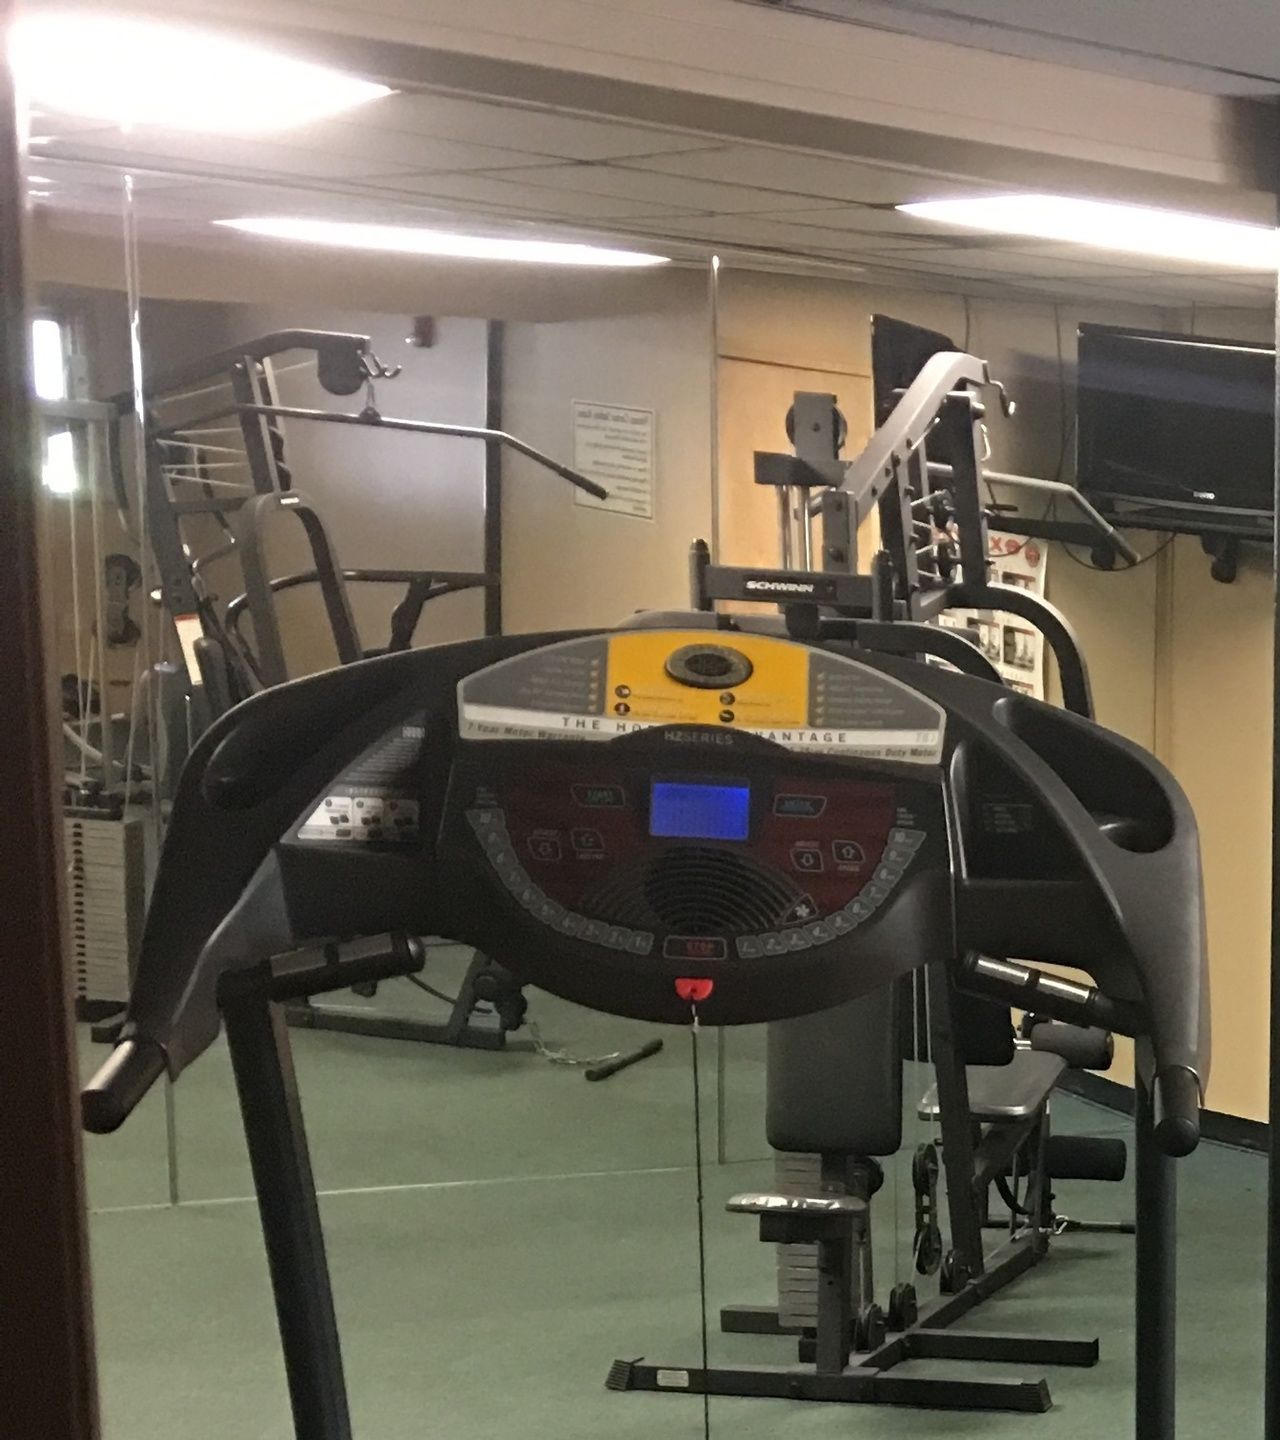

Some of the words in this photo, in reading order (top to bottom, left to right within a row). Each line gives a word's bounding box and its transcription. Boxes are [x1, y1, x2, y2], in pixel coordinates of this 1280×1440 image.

[746, 580, 814, 593] SCHWINN
[563, 716, 601, 730] THE
[477, 723, 500, 736] Year
[504, 726, 533, 739] Motor
